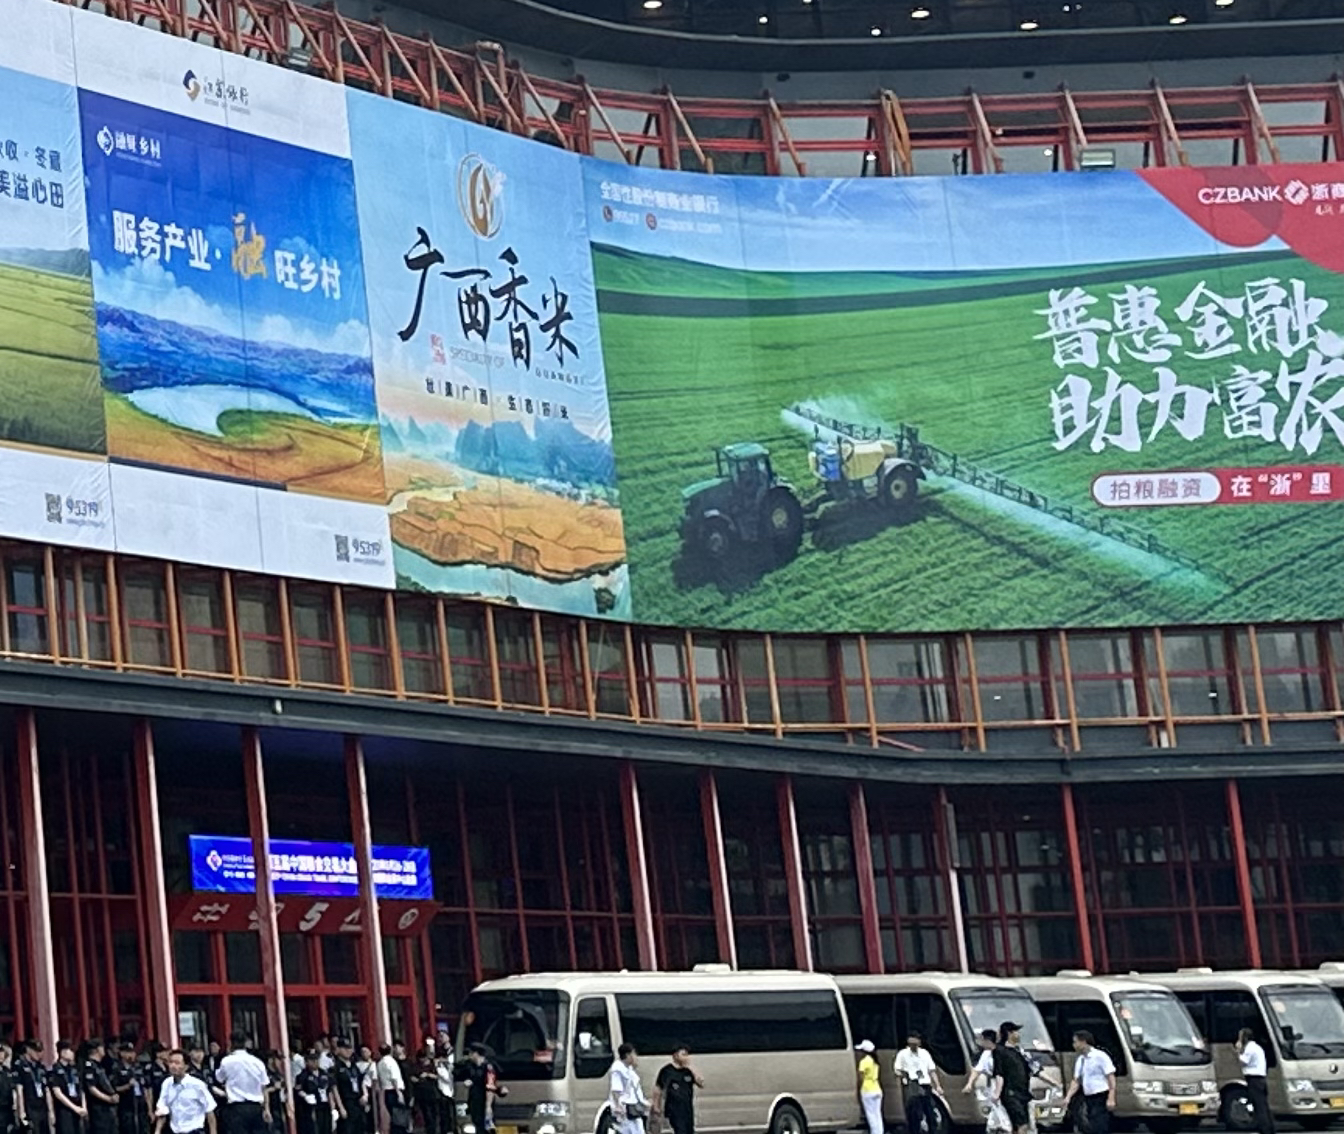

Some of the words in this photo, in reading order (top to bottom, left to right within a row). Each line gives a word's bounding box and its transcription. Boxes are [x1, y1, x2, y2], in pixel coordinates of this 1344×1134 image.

[1197, 185, 1283, 205] CZBANK
[398, 226, 579, 370] 广西香米
[1033, 276, 1344, 368] 普惠金融
[1049, 349, 1344, 455] 助力富农
[1109, 476, 1202, 500] 拍粮融资
